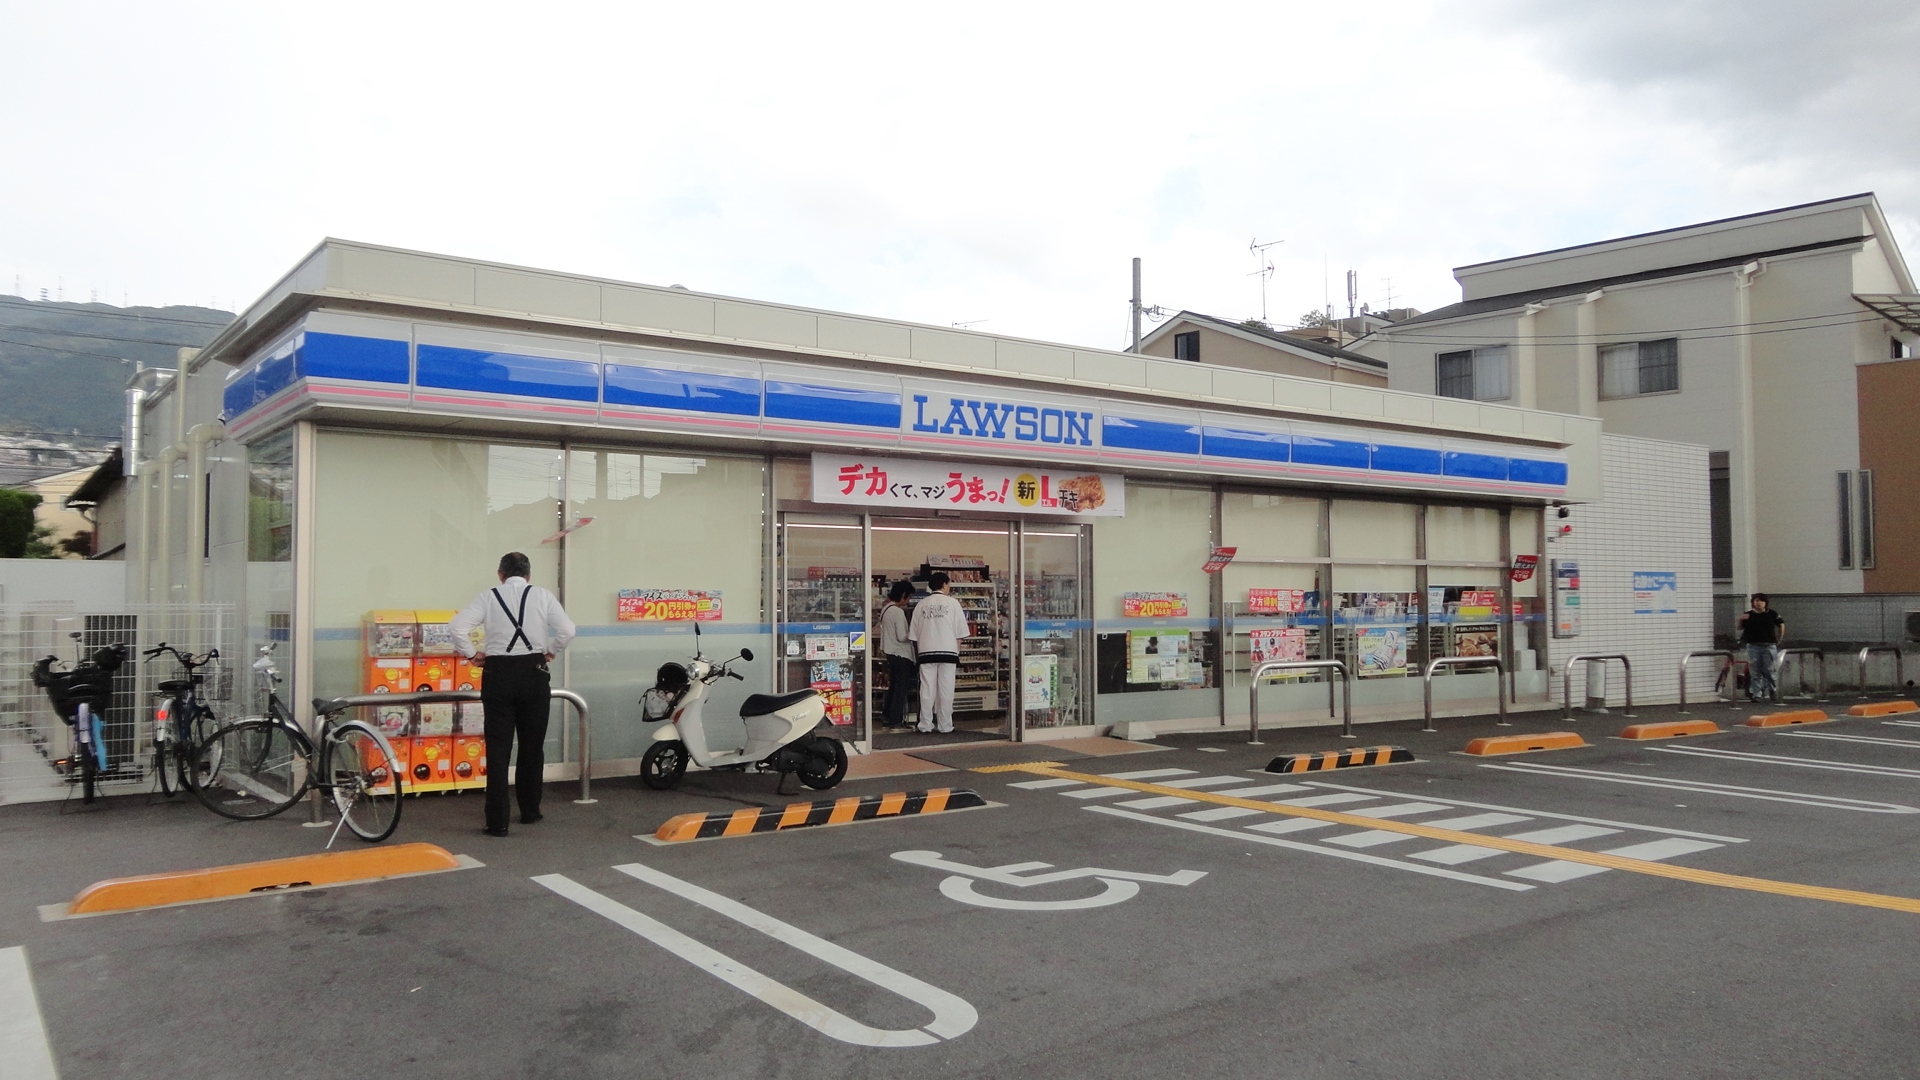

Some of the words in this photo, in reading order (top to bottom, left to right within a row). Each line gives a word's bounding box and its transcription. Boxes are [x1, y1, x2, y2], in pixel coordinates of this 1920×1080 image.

[912, 394, 1093, 447] LAWSON
[1017, 480, 1035, 500] 新
[643, 601, 668, 620] 20
[668, 610, 697, 619] もらえる!
[1139, 601, 1155, 617] 20
[1041, 640, 1052, 649] 24
